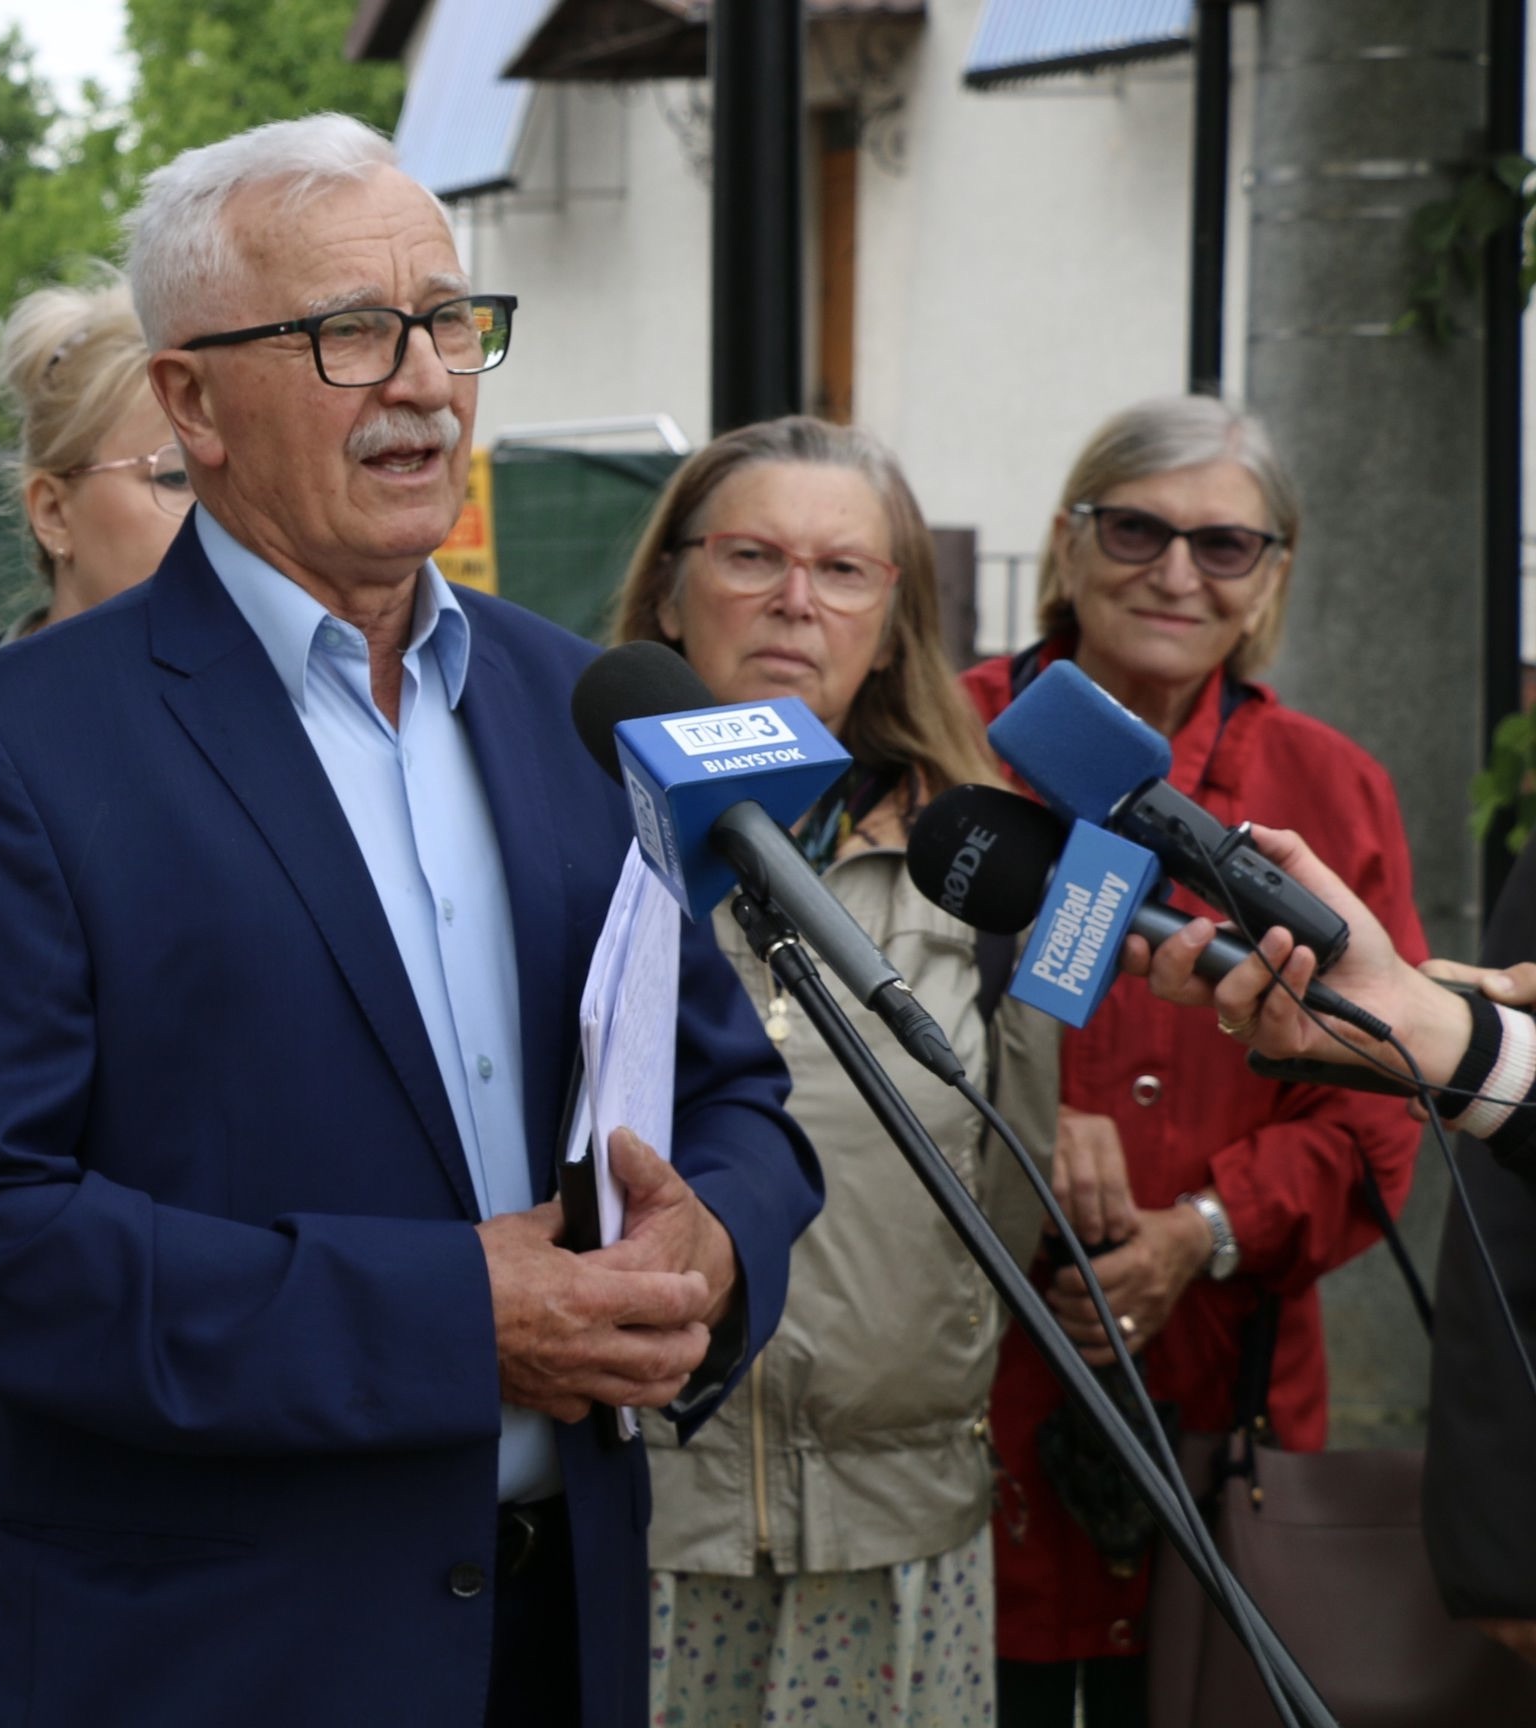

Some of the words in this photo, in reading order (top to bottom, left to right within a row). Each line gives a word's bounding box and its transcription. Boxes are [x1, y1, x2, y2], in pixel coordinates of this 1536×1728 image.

[702, 748, 807, 773] BIAŁYSTOK
[1031, 881, 1092, 984] Przegląd
[1057, 870, 1129, 996] Powiatowy
